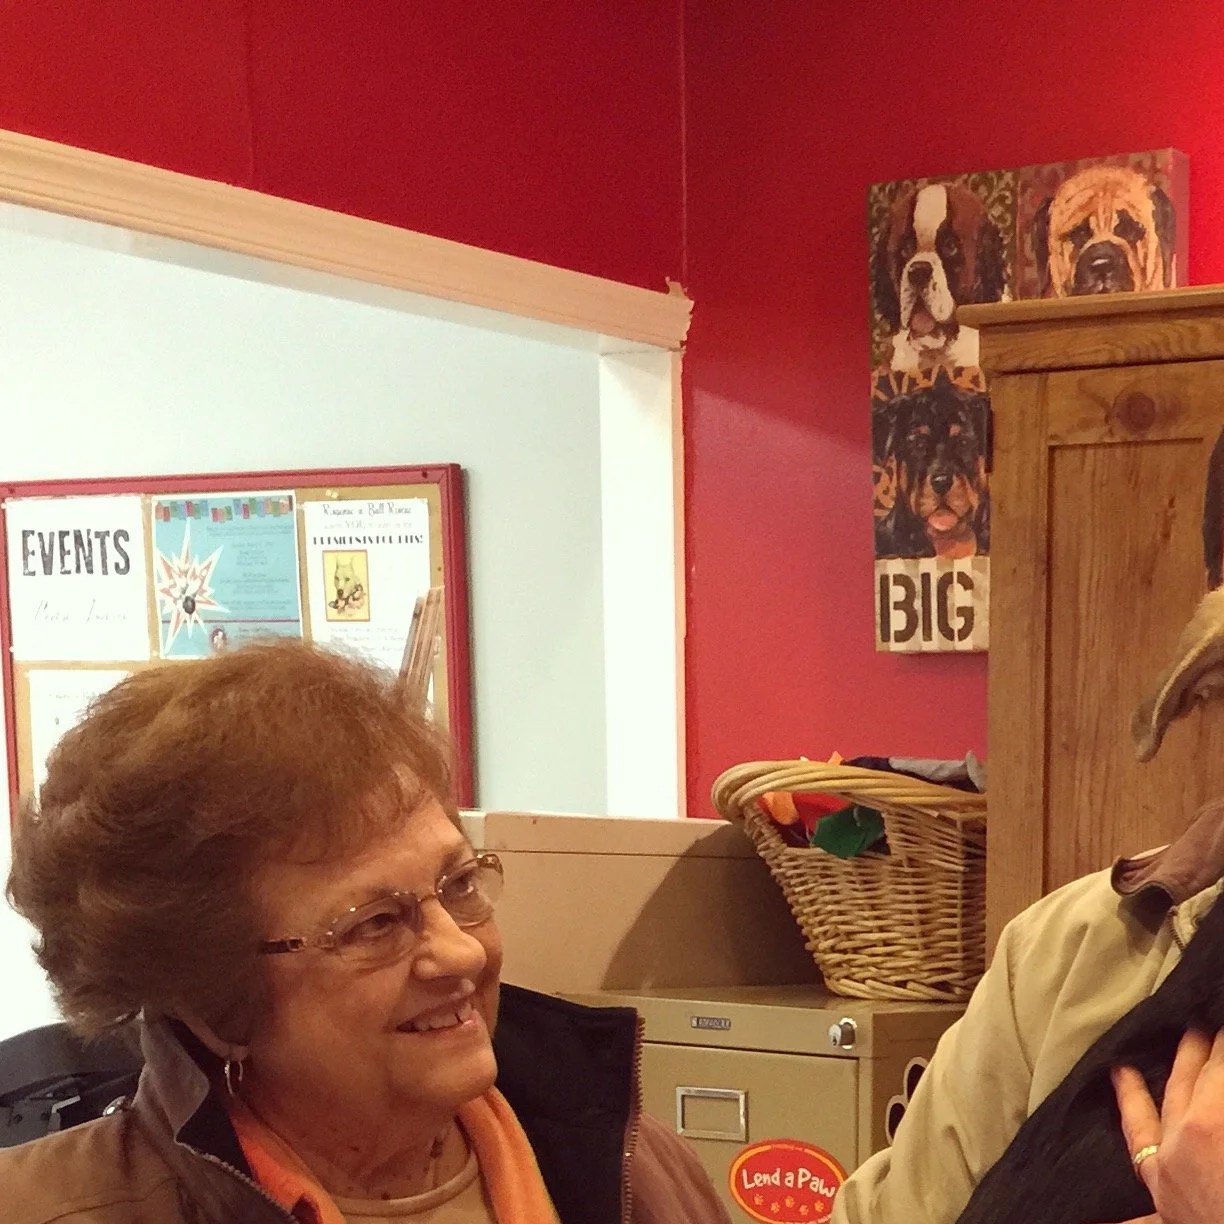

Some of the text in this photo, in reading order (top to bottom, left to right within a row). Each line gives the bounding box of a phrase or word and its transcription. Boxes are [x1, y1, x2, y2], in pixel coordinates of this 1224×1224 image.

[22, 528, 131, 577] EVENTS
[879, 571, 975, 643] BIG
[741, 1167, 836, 1198] Lend a Paw
